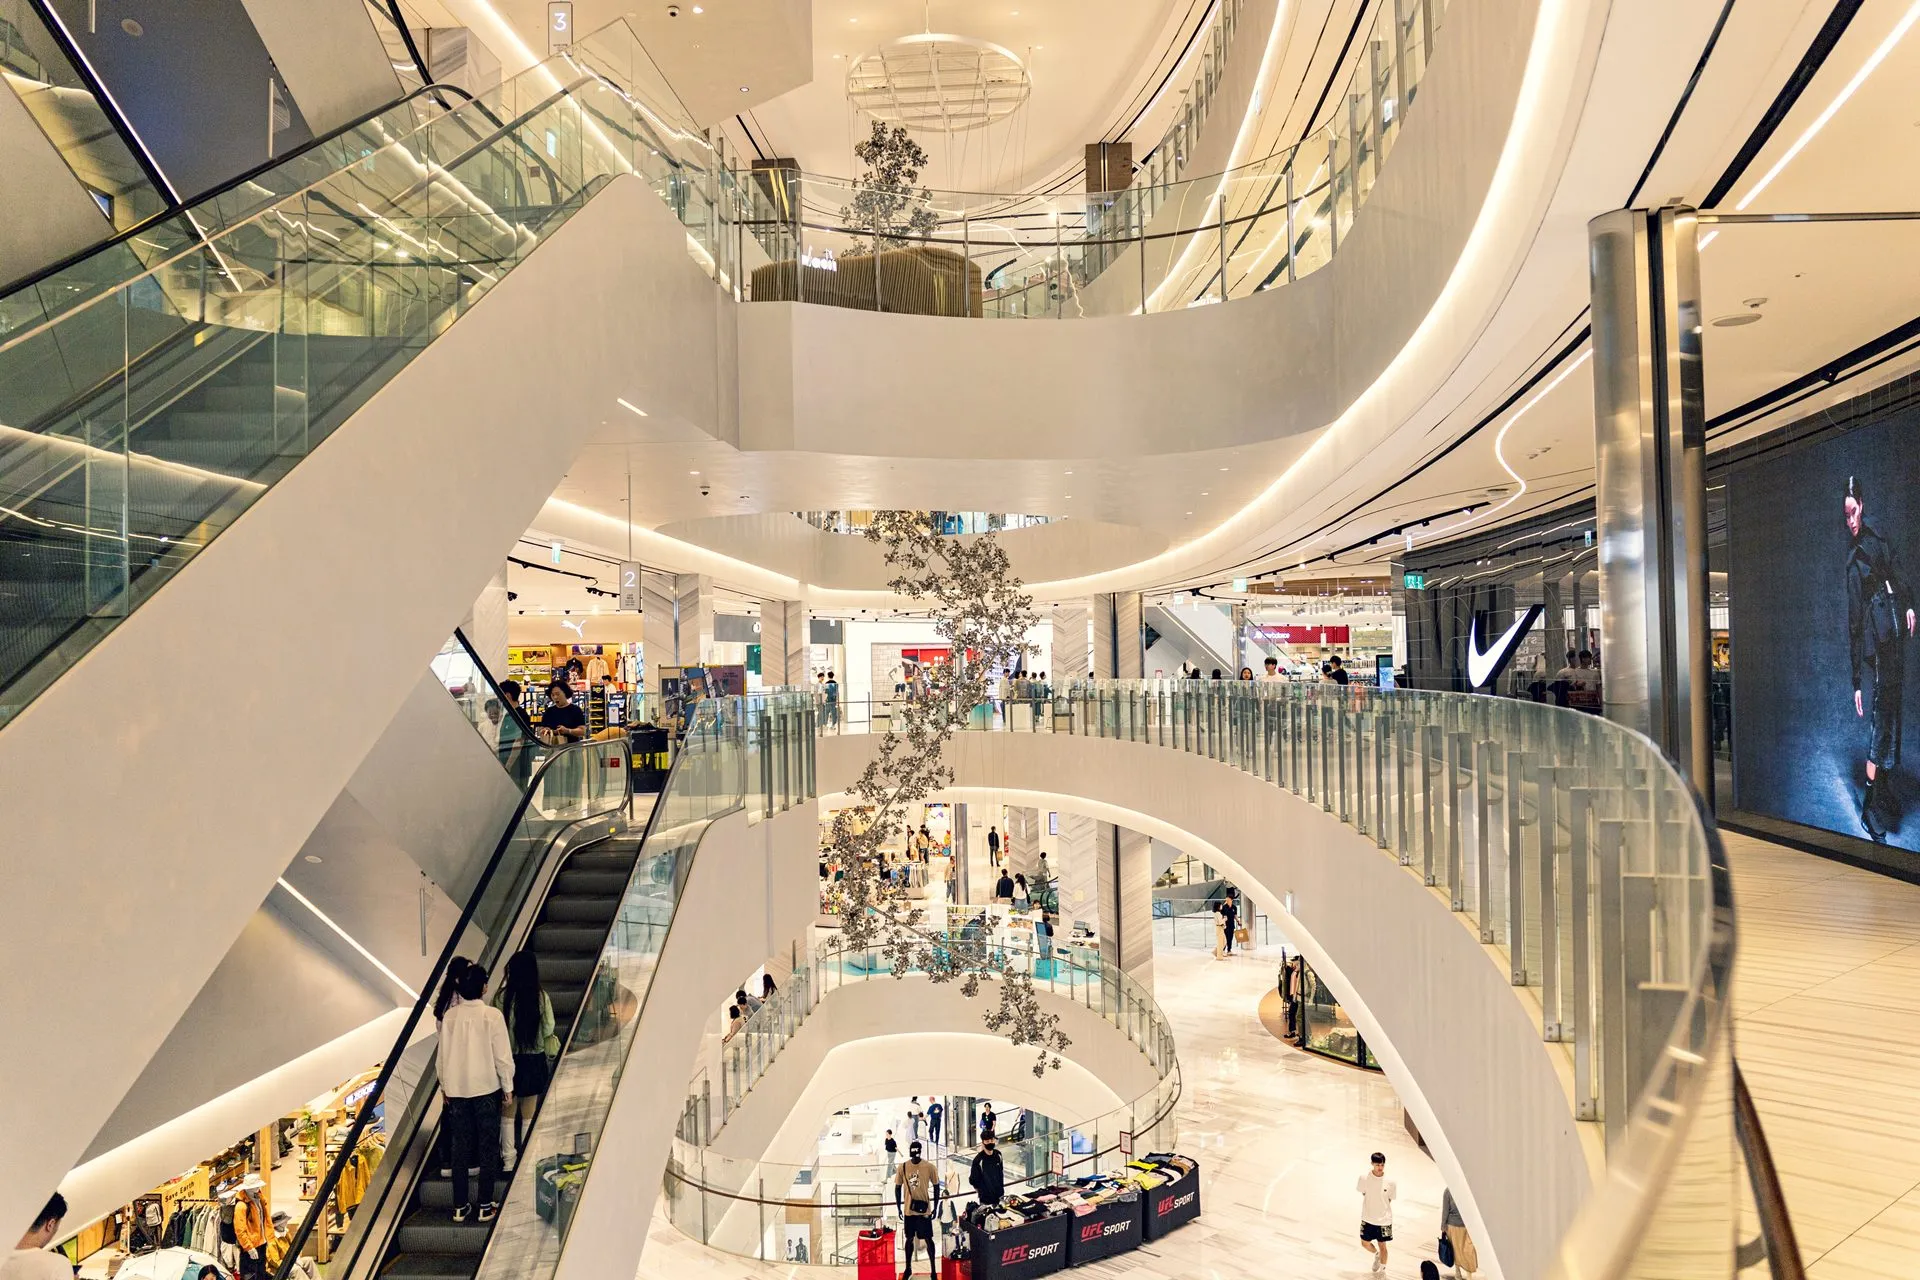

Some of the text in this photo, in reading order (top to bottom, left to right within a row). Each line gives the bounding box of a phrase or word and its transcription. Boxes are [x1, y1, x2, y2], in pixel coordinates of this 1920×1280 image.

[553, 12, 567, 31] 3
[624, 571, 635, 587] 2
[165, 1181, 195, 1202] Save Earth
[1158, 1191, 1195, 1213] UFC SPORT
[1081, 1220, 1131, 1238] UFC SPORT
[1001, 1242, 1060, 1262] UFC SPORT
